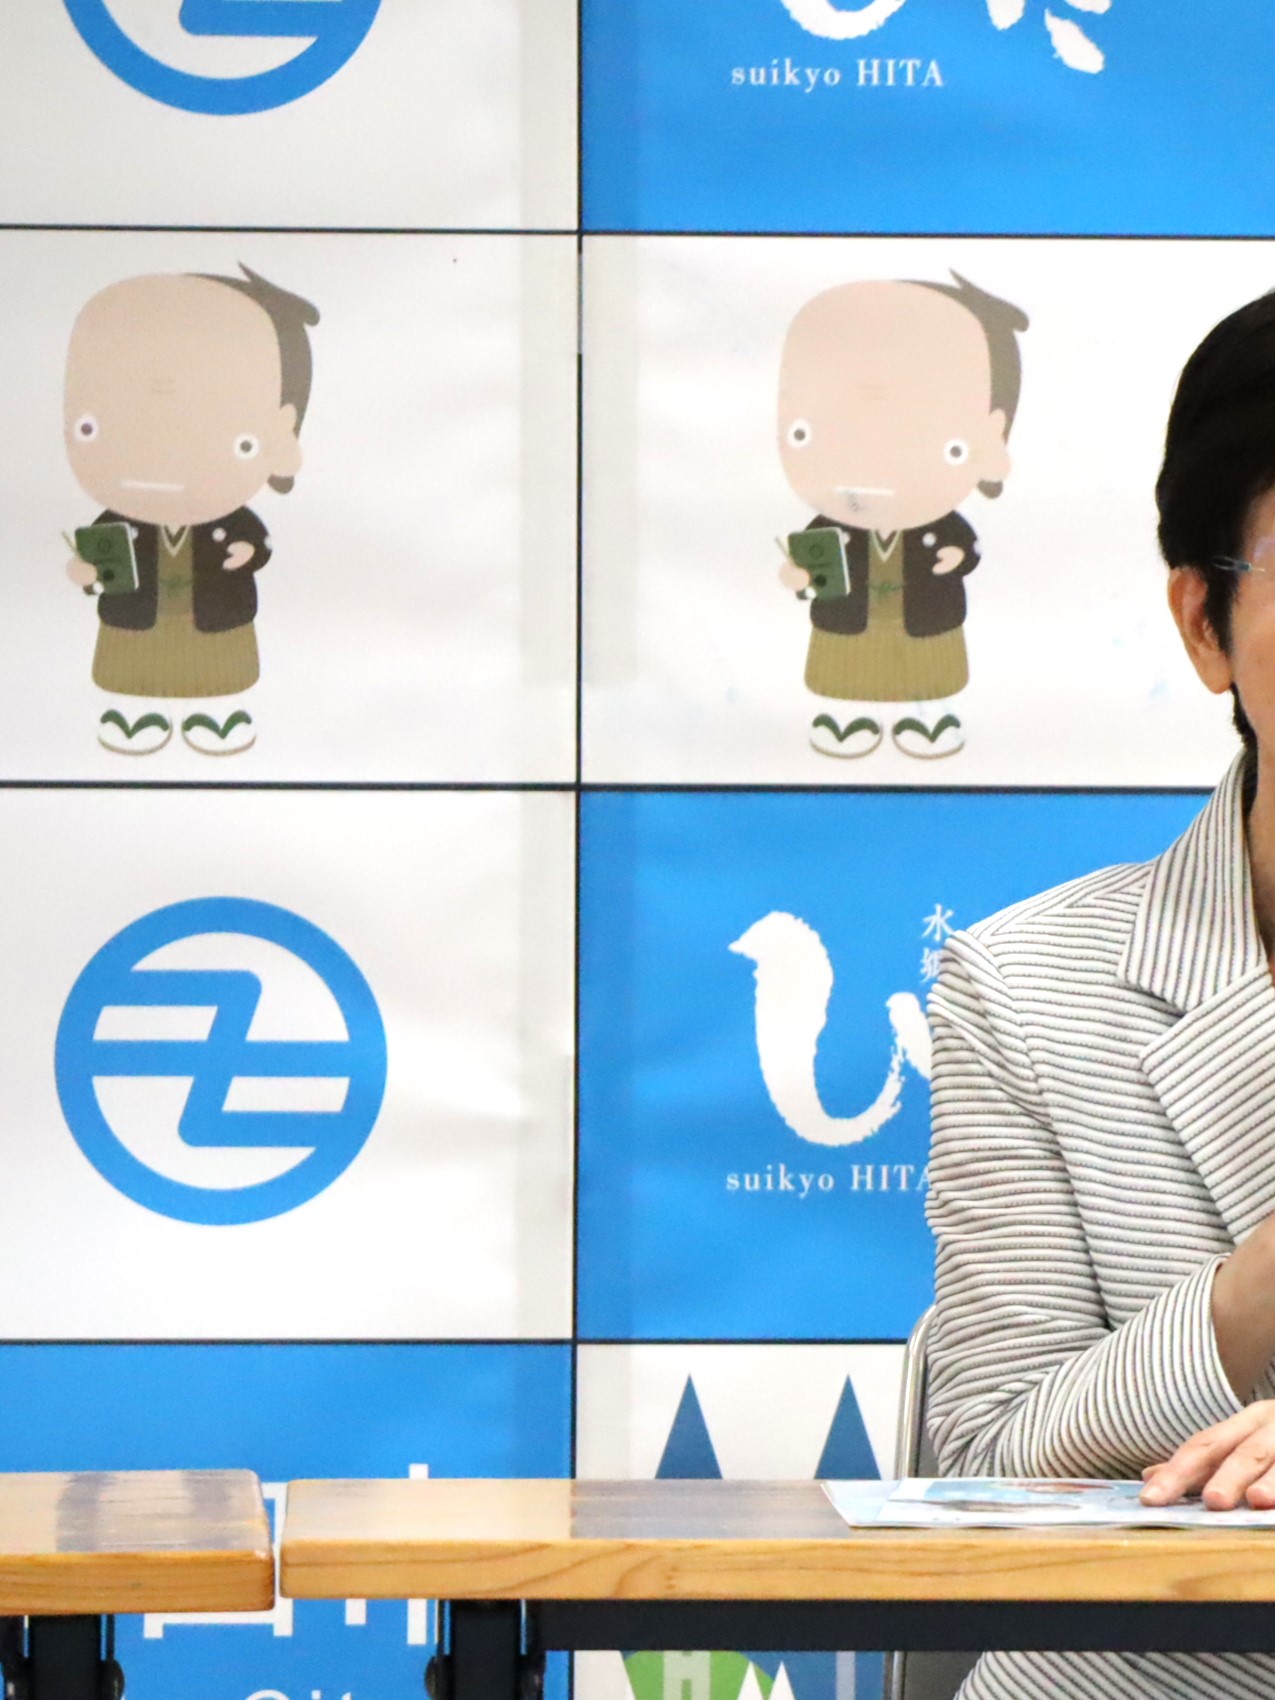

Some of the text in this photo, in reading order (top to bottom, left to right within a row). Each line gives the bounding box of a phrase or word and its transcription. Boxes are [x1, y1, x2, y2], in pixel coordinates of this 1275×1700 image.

[731, 58, 944, 93] suikyo HITA
[726, 1163, 835, 1199] suikyo
